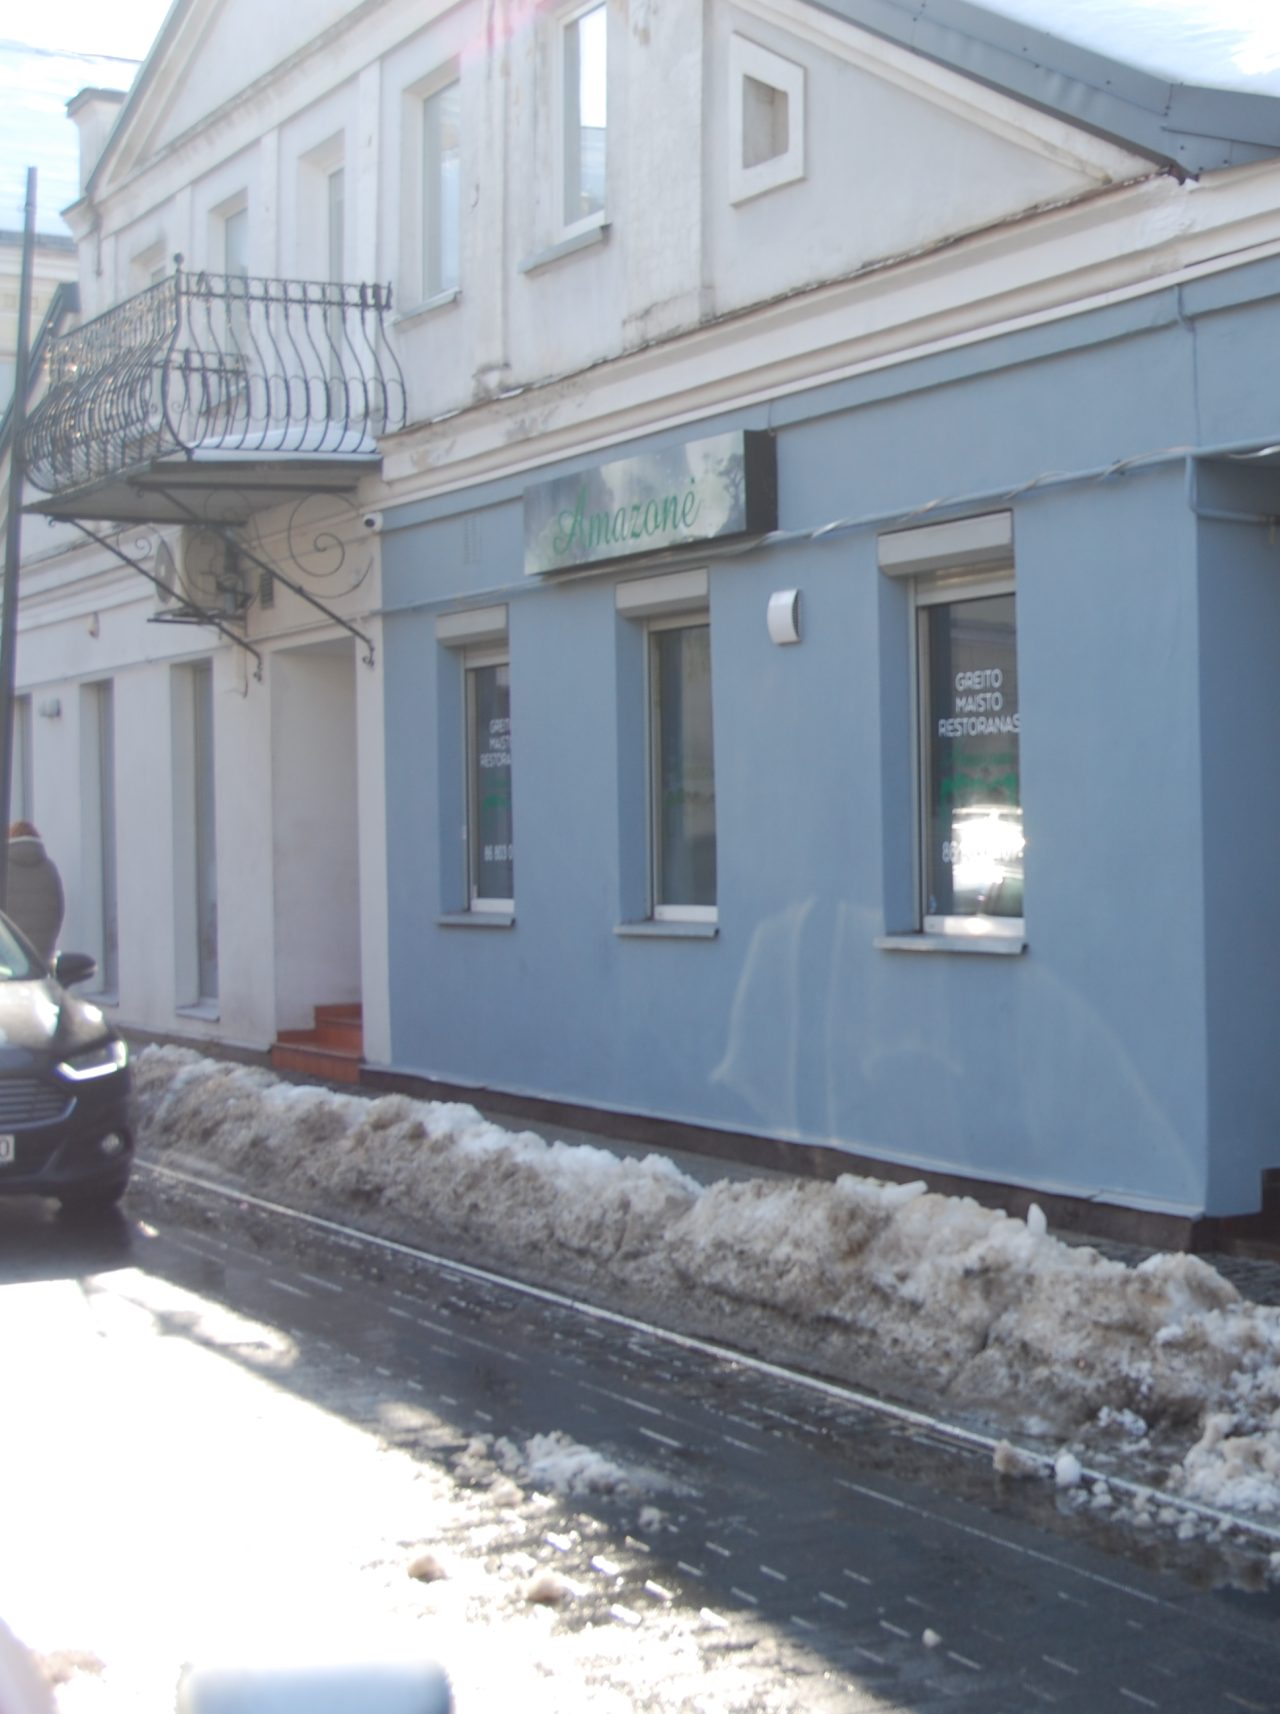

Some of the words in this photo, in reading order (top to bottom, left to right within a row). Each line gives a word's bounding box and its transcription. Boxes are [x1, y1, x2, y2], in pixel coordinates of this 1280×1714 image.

[955, 668, 1003, 692] GREITO
[955, 691, 1003, 713] MAISTO
[489, 718, 511, 734] GREIT
[938, 713, 1021, 738] RESTORANAS
[489, 735, 511, 750] MAIST
[480, 752, 511, 768] RESTORA
